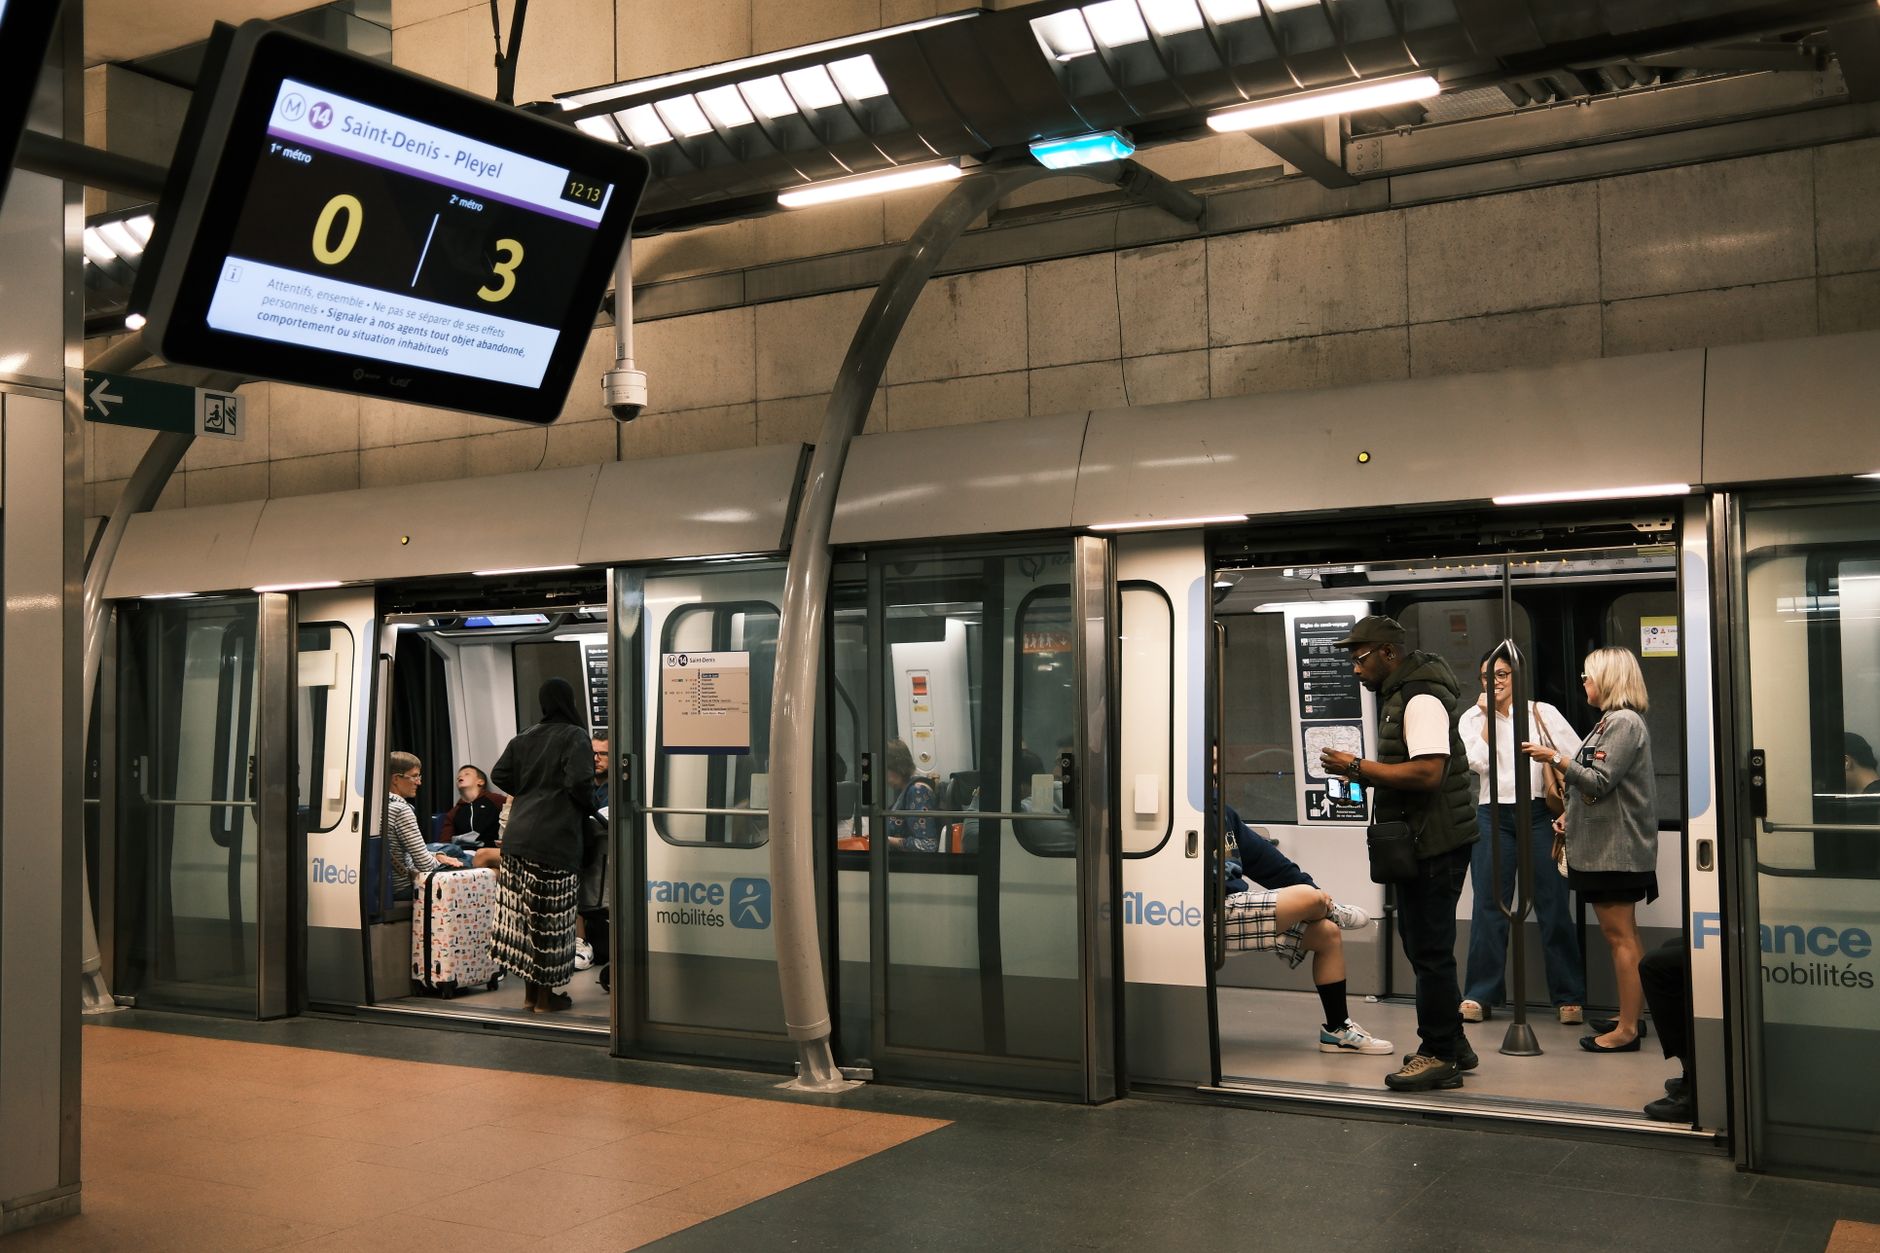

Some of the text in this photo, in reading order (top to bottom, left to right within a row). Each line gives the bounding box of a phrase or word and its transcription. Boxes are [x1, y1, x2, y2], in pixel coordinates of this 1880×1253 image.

[282, 147, 313, 164] métro
[310, 104, 331, 127] 14
[341, 115, 441, 160] Saint-Denis
[454, 149, 504, 179] Pleyel
[311, 193, 364, 266] 0
[459, 197, 484, 213] métro
[476, 238, 525, 303] 3
[256, 310, 450, 357] comportement ou situation inhabituels
[261, 295, 526, 359] personnels Signaler à nos agents tout objet abandonné,
[267, 278, 506, 339] Attentifs, ensemble Ne pas se séparer de ses effets
[656, 907, 725, 928] mobilités
